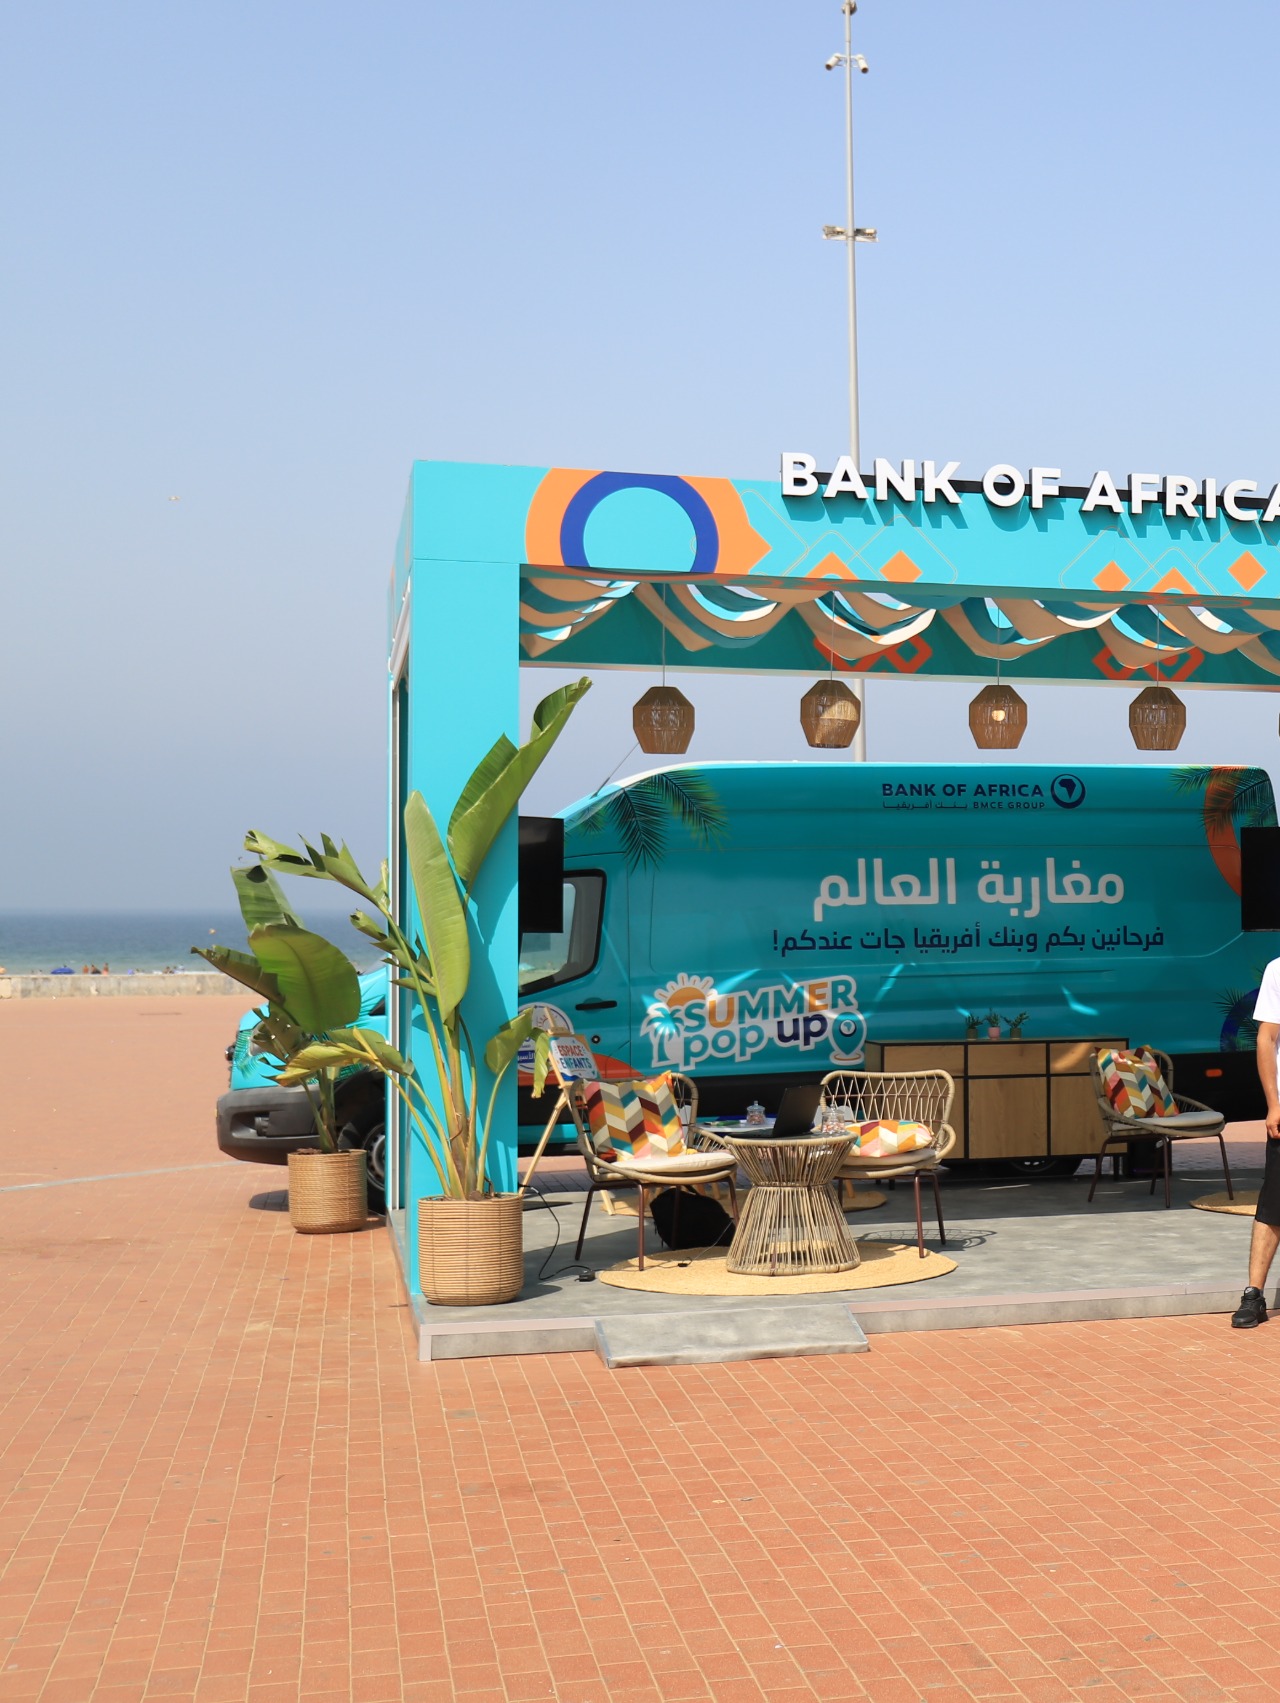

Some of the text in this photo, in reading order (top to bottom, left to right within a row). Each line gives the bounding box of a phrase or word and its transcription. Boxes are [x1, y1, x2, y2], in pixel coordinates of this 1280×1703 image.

[781, 451, 962, 505] BANK
[982, 464, 1062, 509] OF
[882, 783, 1044, 798] BANK OF AFRICA
[973, 801, 1045, 810] BMCE GROUP
[813, 857, 1124, 922] مغاربة العالم
[774, 922, 1164, 957] فرحانين بكم وبنك أفريقيا جات عندكم!
[683, 981, 855, 1034] SUMMER
[558, 1045, 584, 1057] ESPACE
[684, 1013, 828, 1067] pop up
[560, 1057, 593, 1069] ENFANTS
